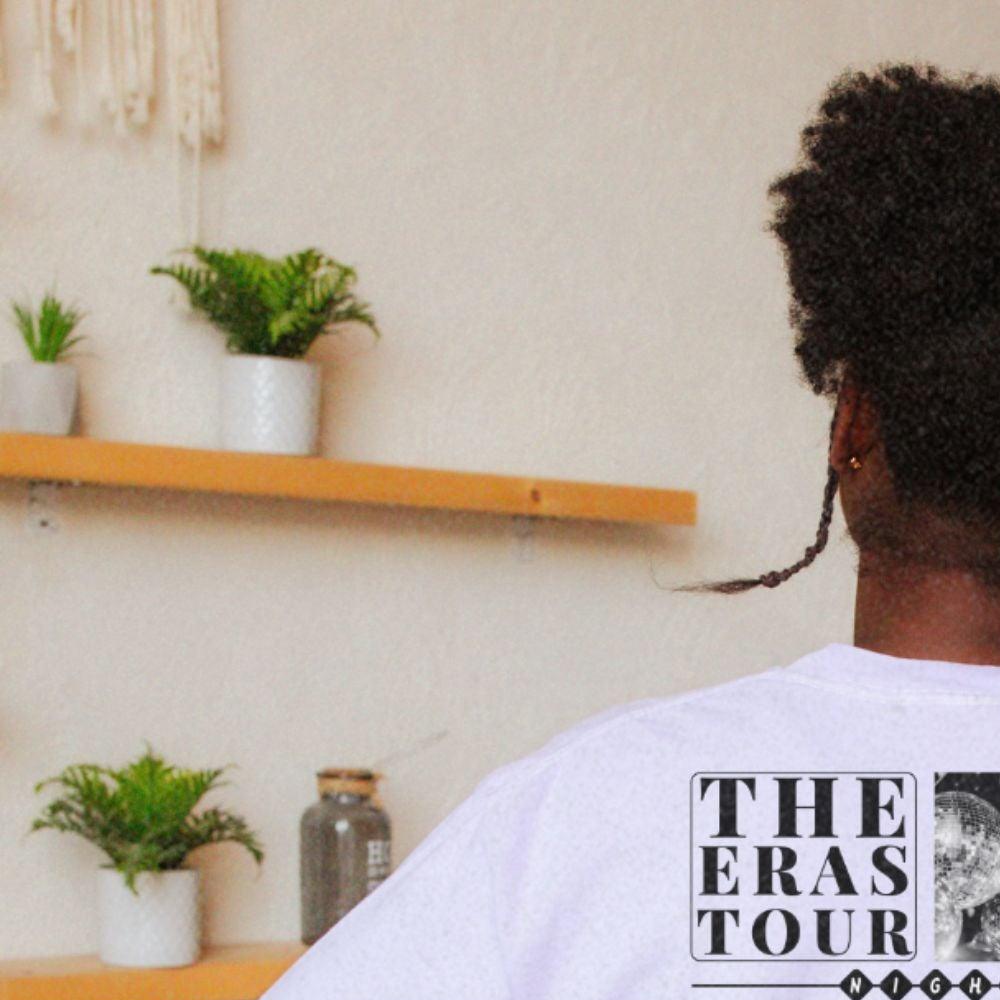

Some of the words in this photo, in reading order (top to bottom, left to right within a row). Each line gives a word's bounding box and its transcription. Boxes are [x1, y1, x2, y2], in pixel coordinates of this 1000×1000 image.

[699, 777, 906, 839] THE
[698, 844, 909, 897] ERAS
[697, 908, 913, 957] TOUR
